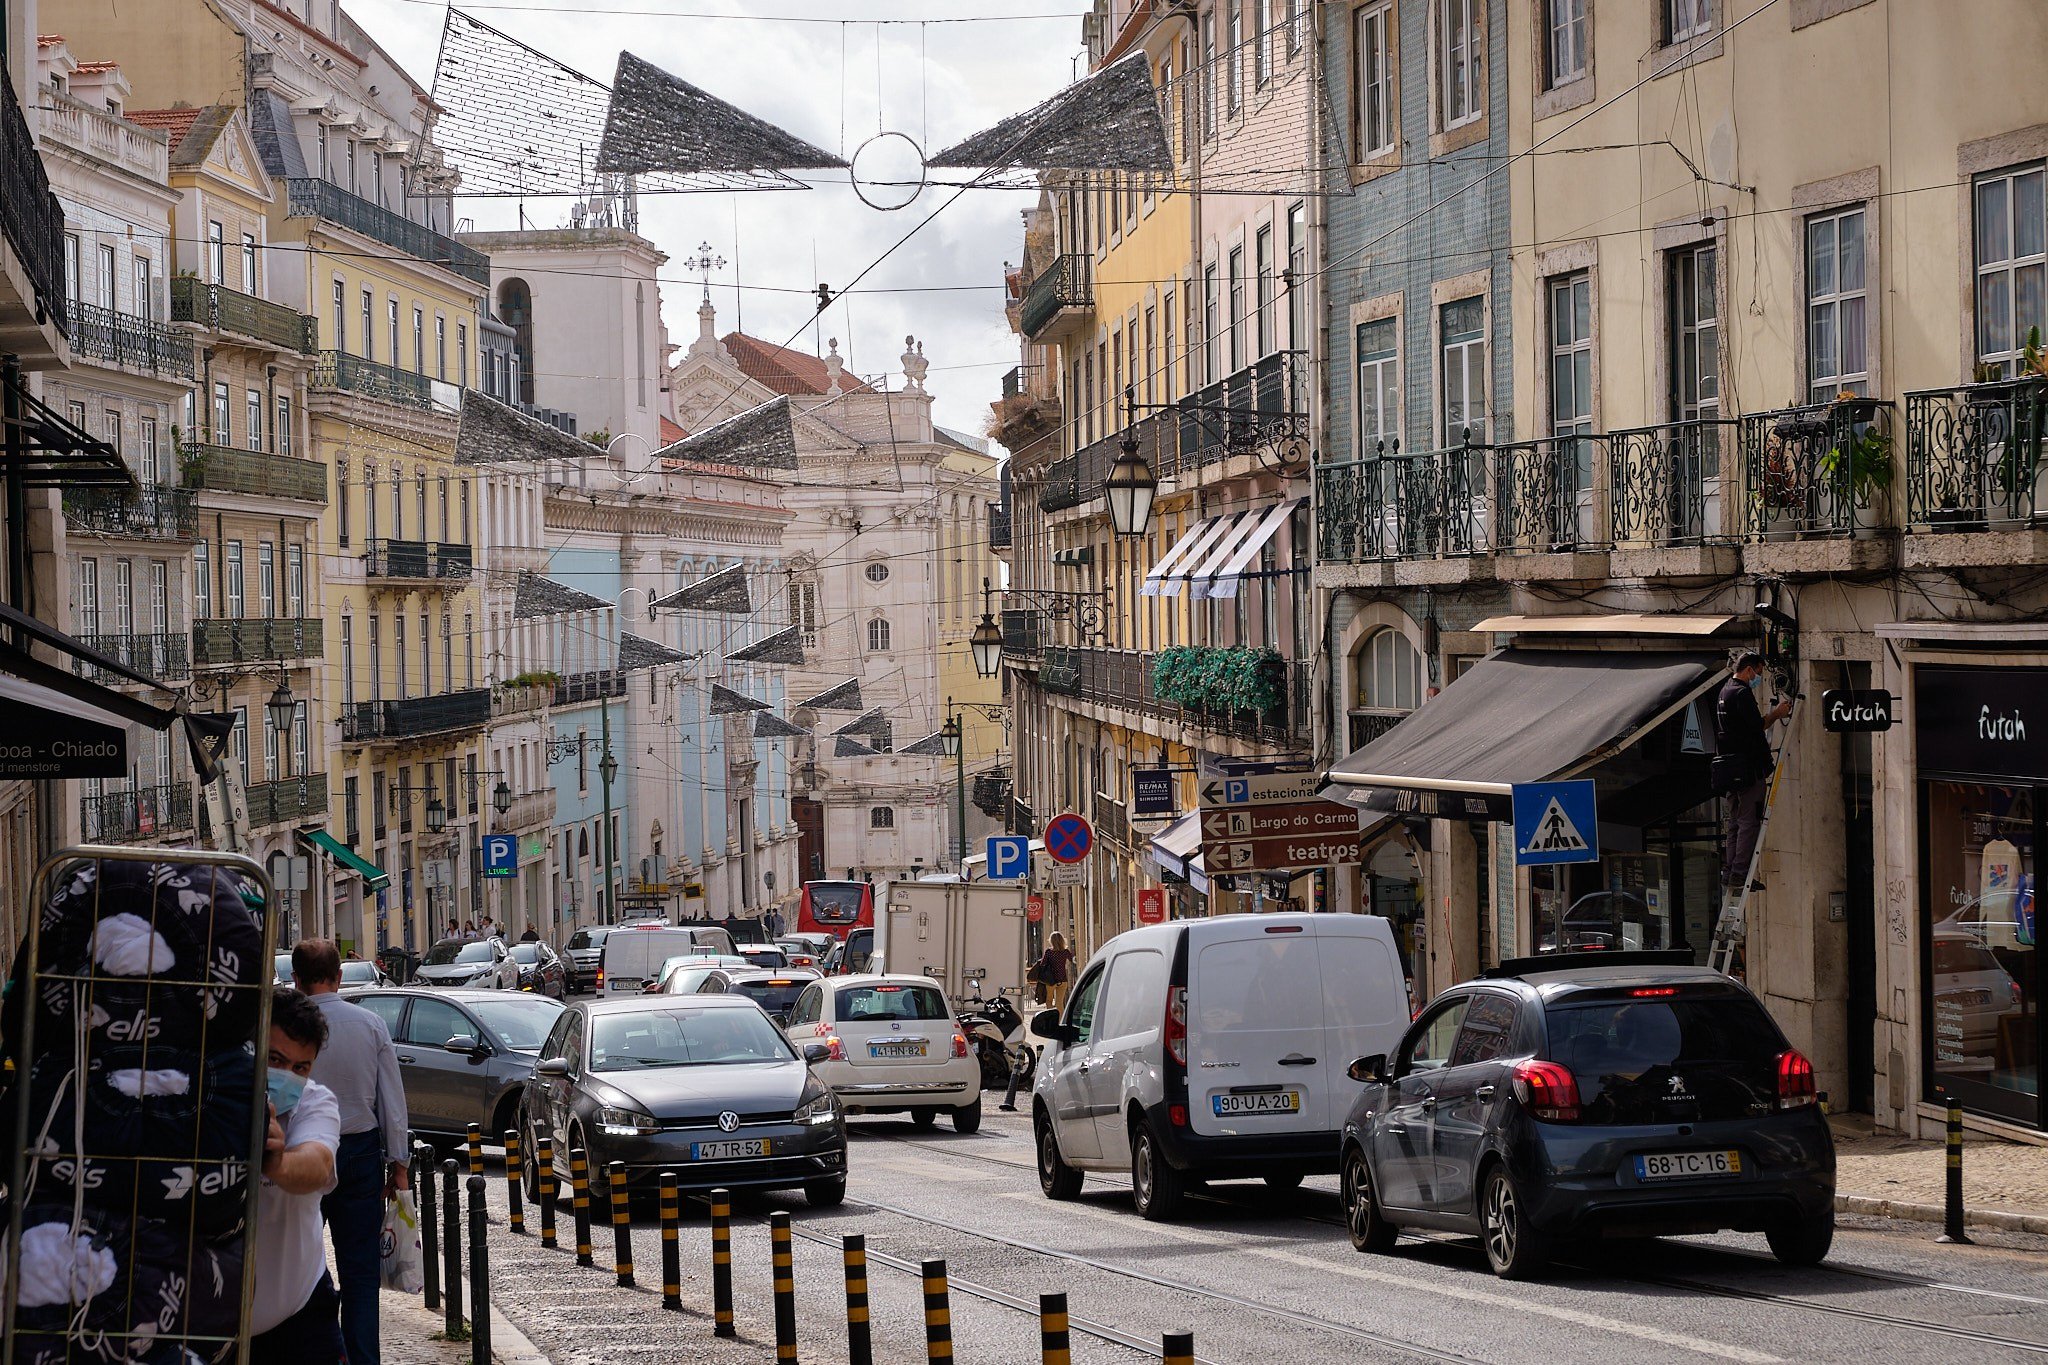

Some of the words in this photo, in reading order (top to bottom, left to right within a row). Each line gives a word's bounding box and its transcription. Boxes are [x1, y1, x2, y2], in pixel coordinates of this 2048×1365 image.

[1830, 700, 1887, 722] futah
[1978, 704, 2026, 741] futah
[1685, 729, 1700, 739] DELTA
[52, 740, 118, 757] Chiado
[8, 762, 61, 773] menstore
[1229, 781, 1244, 796] P
[1252, 787, 1317, 799] estaciona
[1252, 817, 1289, 829] Largo
[1293, 815, 1309, 826] do
[1314, 813, 1357, 824] Carmo
[490, 842, 508, 866] P
[995, 841, 1020, 876] P
[1287, 842, 1359, 861] teatros
[1950, 885, 1973, 904] futah
[106, 1009, 161, 1042] elis
[1937, 1022, 1963, 1039] clothing
[1938, 1048, 1964, 1063] blankets
[159, 1271, 186, 1333] elis
